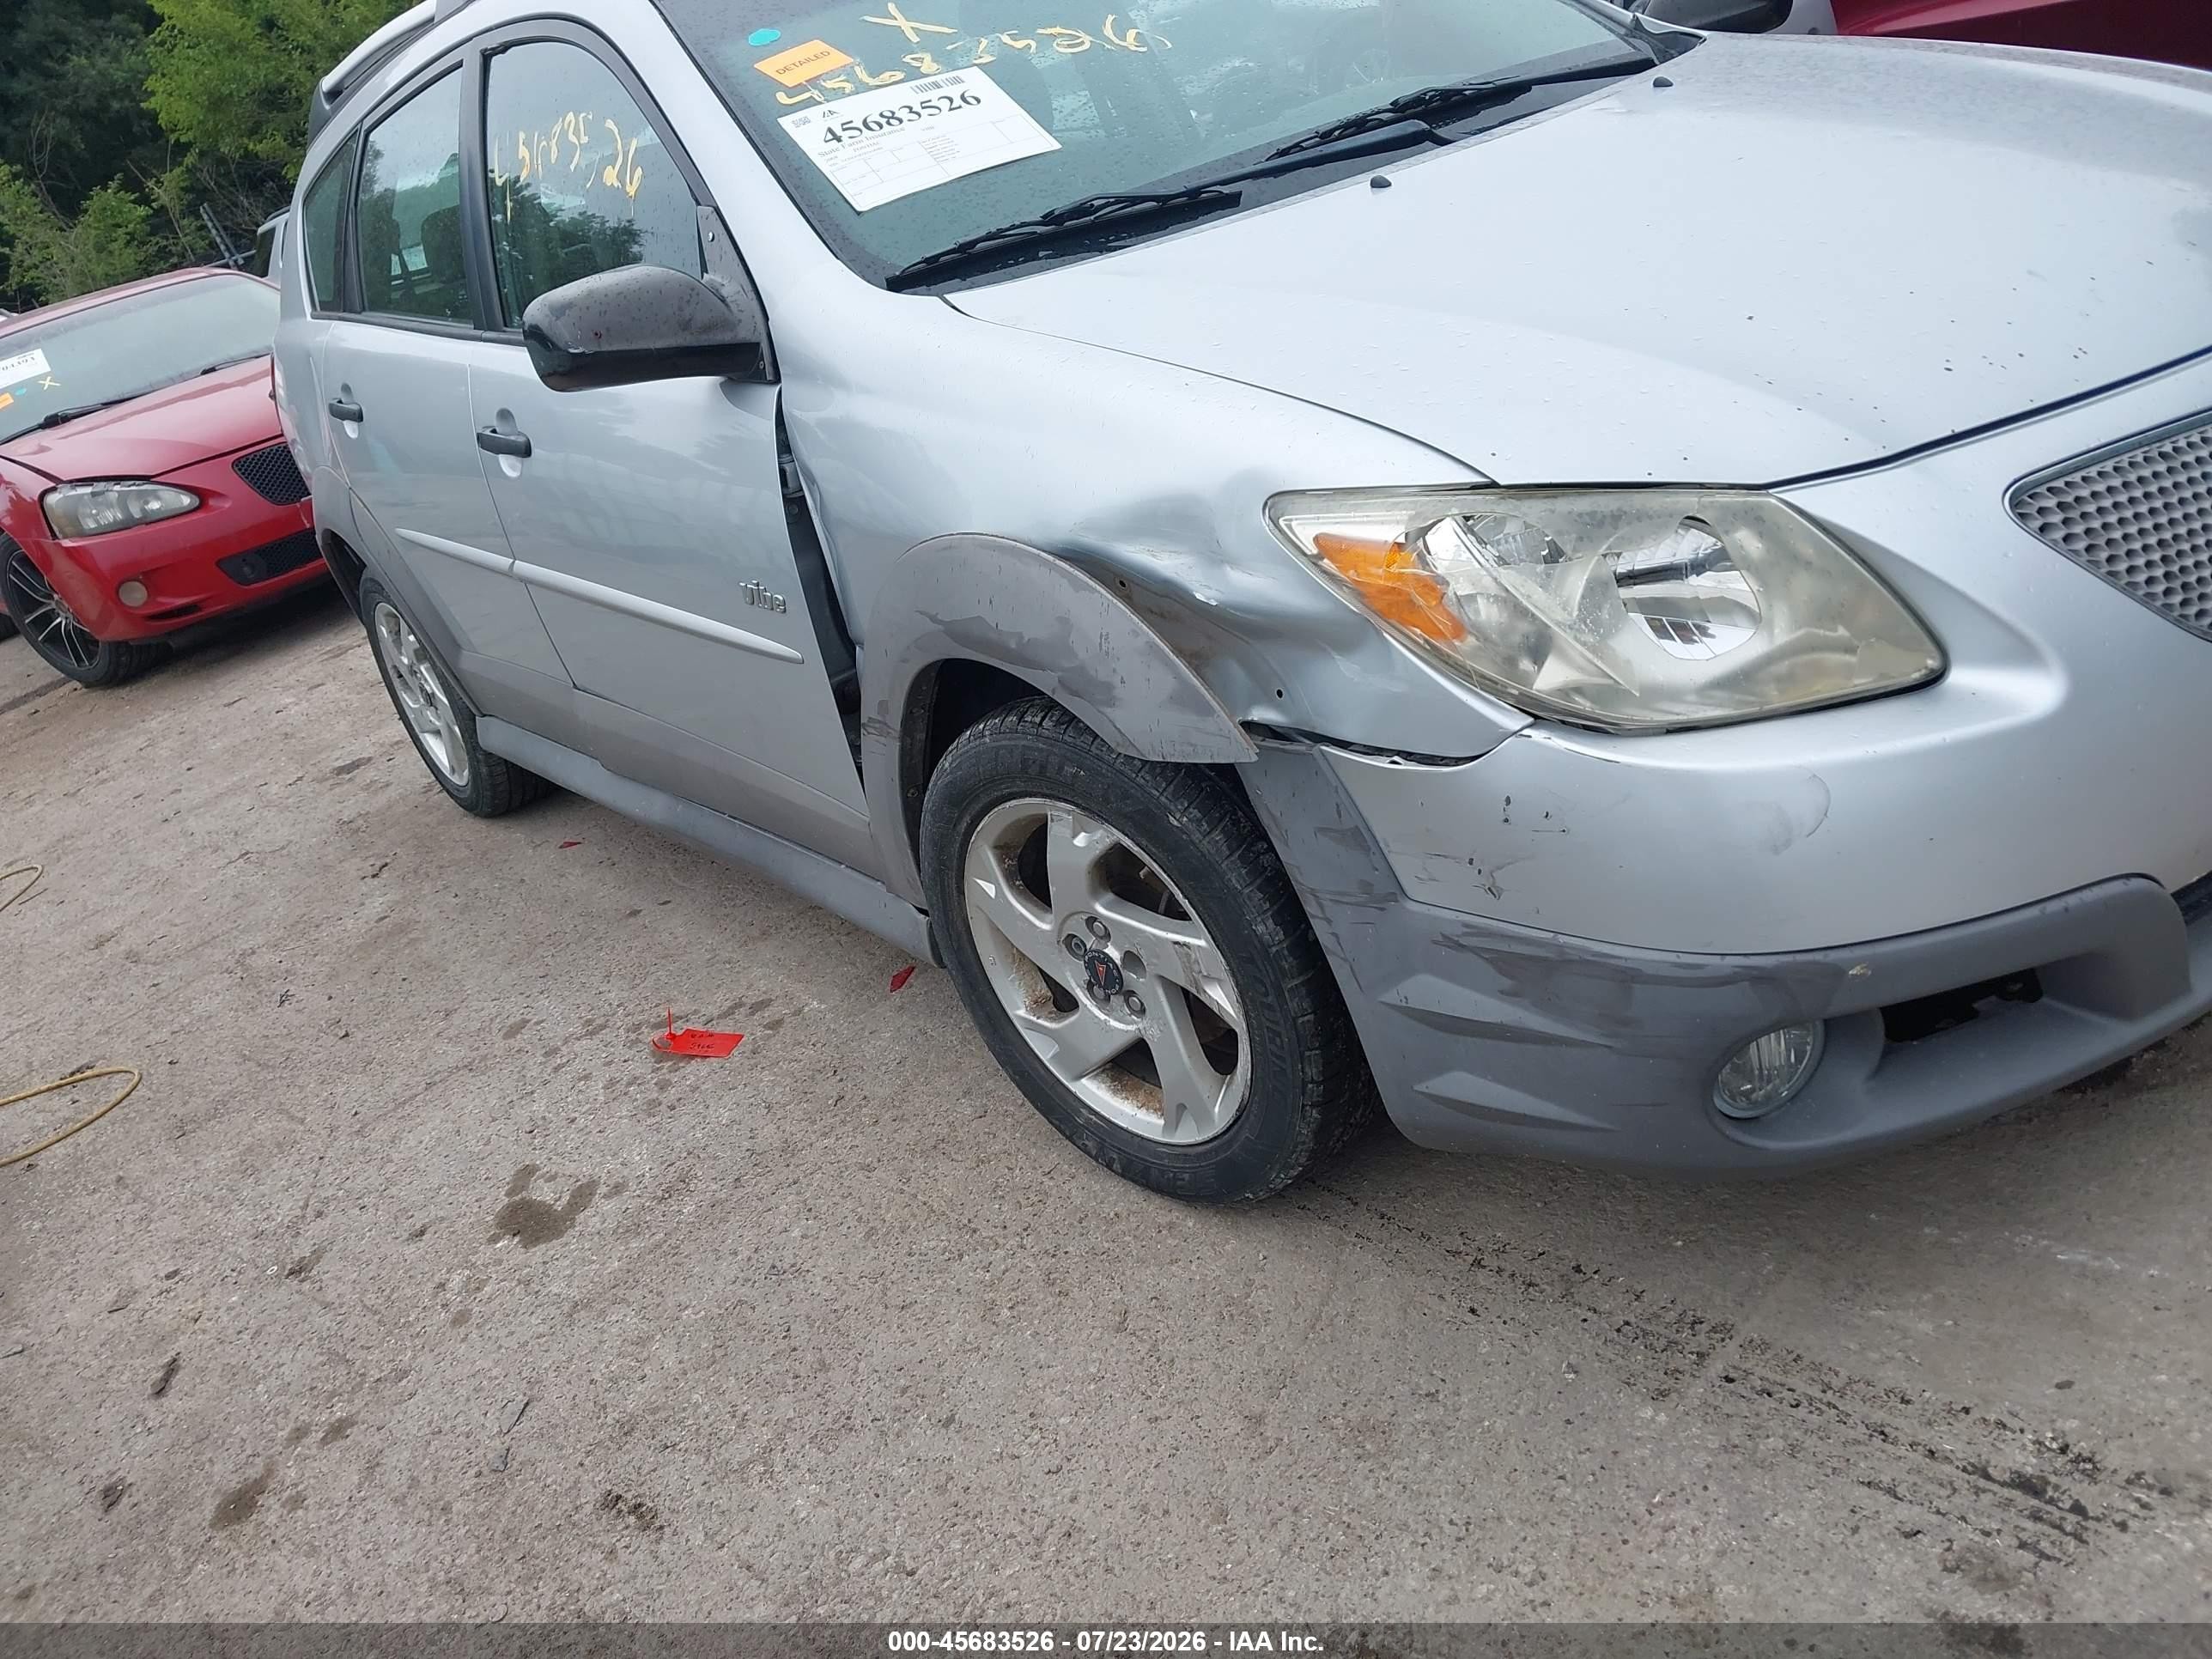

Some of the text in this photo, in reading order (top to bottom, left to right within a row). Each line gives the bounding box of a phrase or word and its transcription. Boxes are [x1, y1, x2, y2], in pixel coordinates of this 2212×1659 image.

[775, 50, 831, 76] DETAILED
[823, 88, 981, 143] 45683526
[817, 146, 840, 158] State
